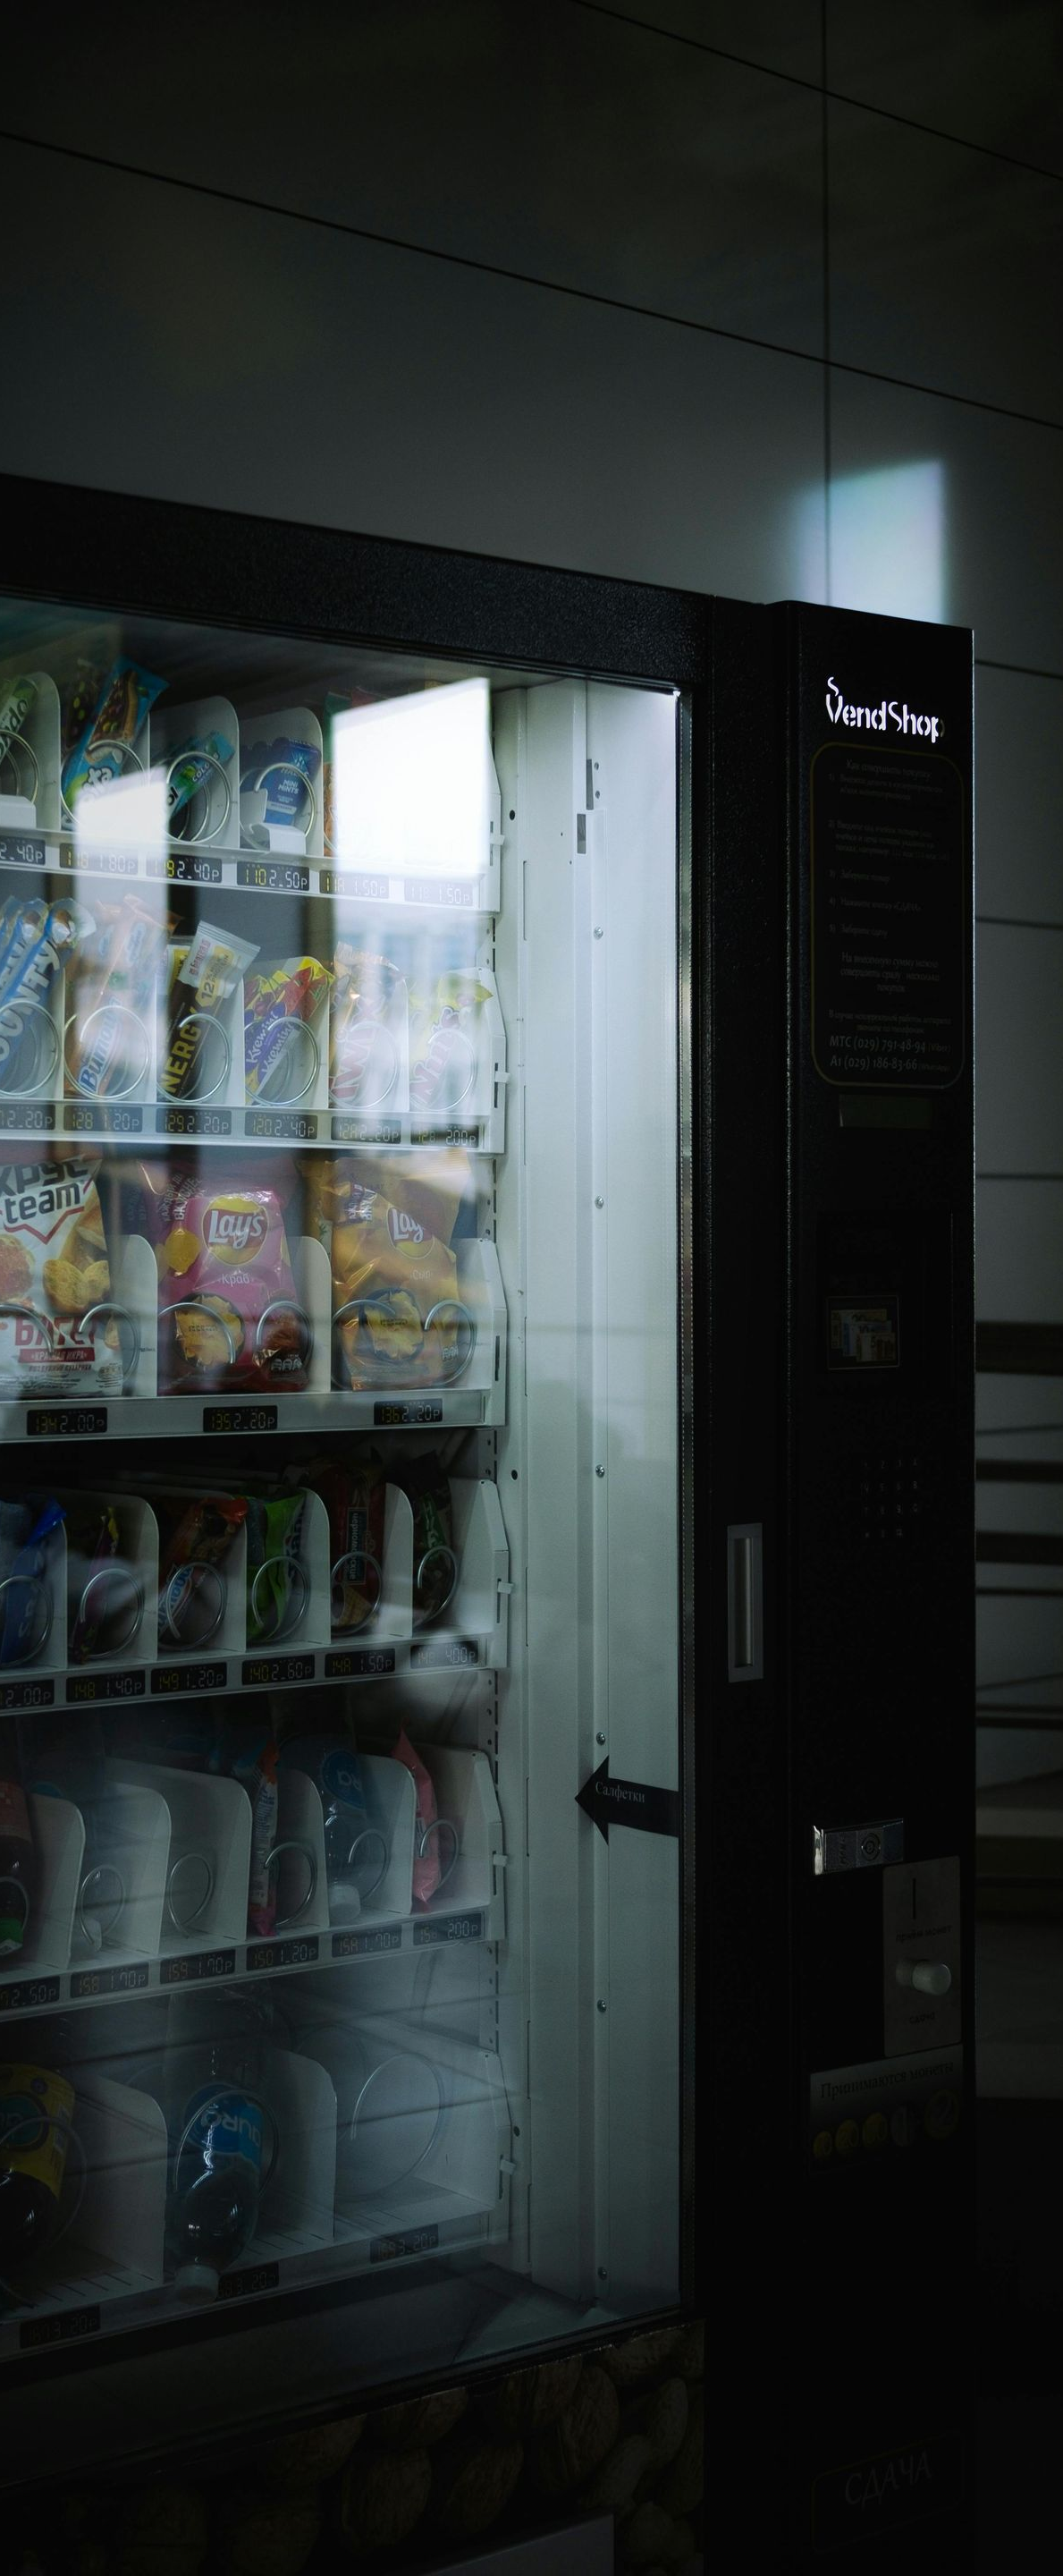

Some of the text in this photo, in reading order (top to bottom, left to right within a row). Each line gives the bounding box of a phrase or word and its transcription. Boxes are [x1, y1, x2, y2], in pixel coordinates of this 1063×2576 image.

[825, 677, 945, 743] VendShop
[277, 784, 299, 795] MINTS
[283, 778, 299, 789] MINI
[853, 1035, 880, 1052] (029)
[882, 1038, 925, 1054] 791-48-94
[844, 1055, 871, 1071] (029)
[873, 1057, 918, 1072] 186-83-66
[4, 1182, 81, 1224] team
[208, 1209, 264, 1250] Lay's
[595, 1781, 645, 1803] Салфетки
[821, 2062, 954, 2100] Принимаются монеты
